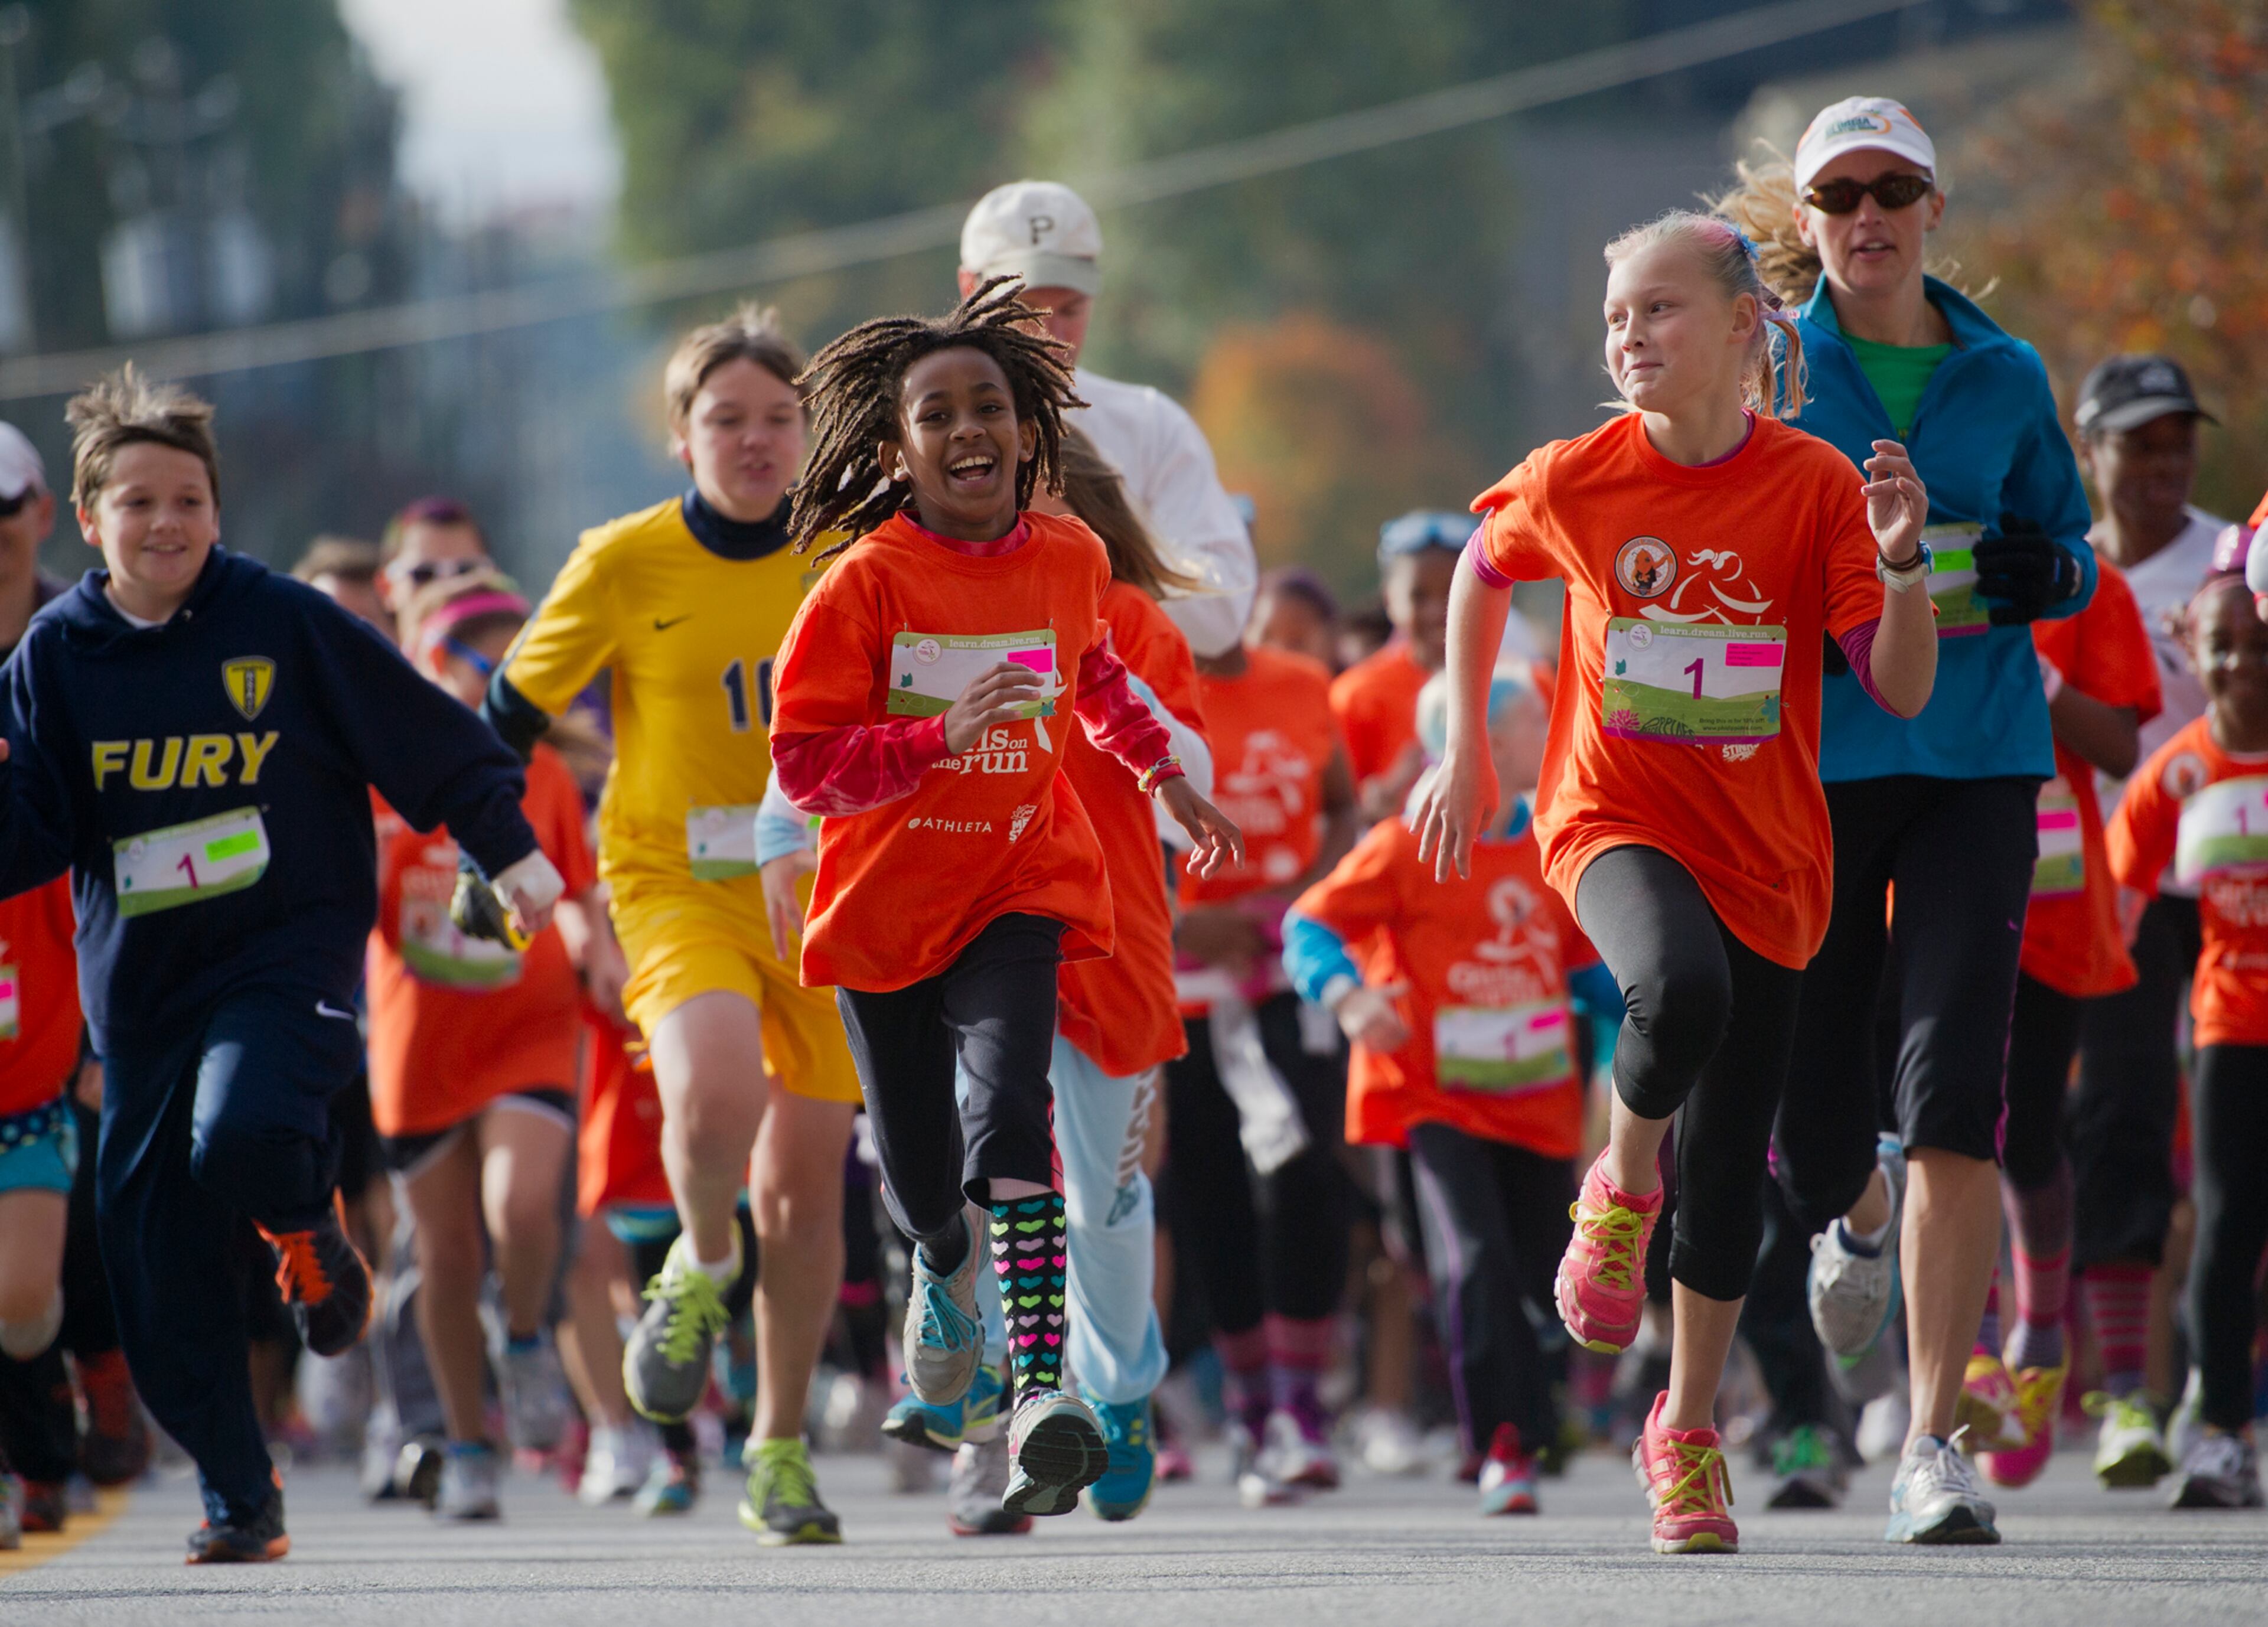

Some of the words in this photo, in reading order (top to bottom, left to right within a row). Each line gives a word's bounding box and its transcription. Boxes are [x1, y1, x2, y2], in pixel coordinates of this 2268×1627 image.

[1029, 216, 1054, 244] P
[950, 637, 1042, 648] learn.dream.live.run.
[1660, 625, 1770, 638] learn.dream.live.run.
[1684, 657, 1704, 700] 1
[1009, 739, 1028, 749] on
[92, 731, 279, 792] FURY
[959, 750, 1029, 775] run
[923, 817, 992, 833] ATHLETA
[177, 853, 199, 891] 1
